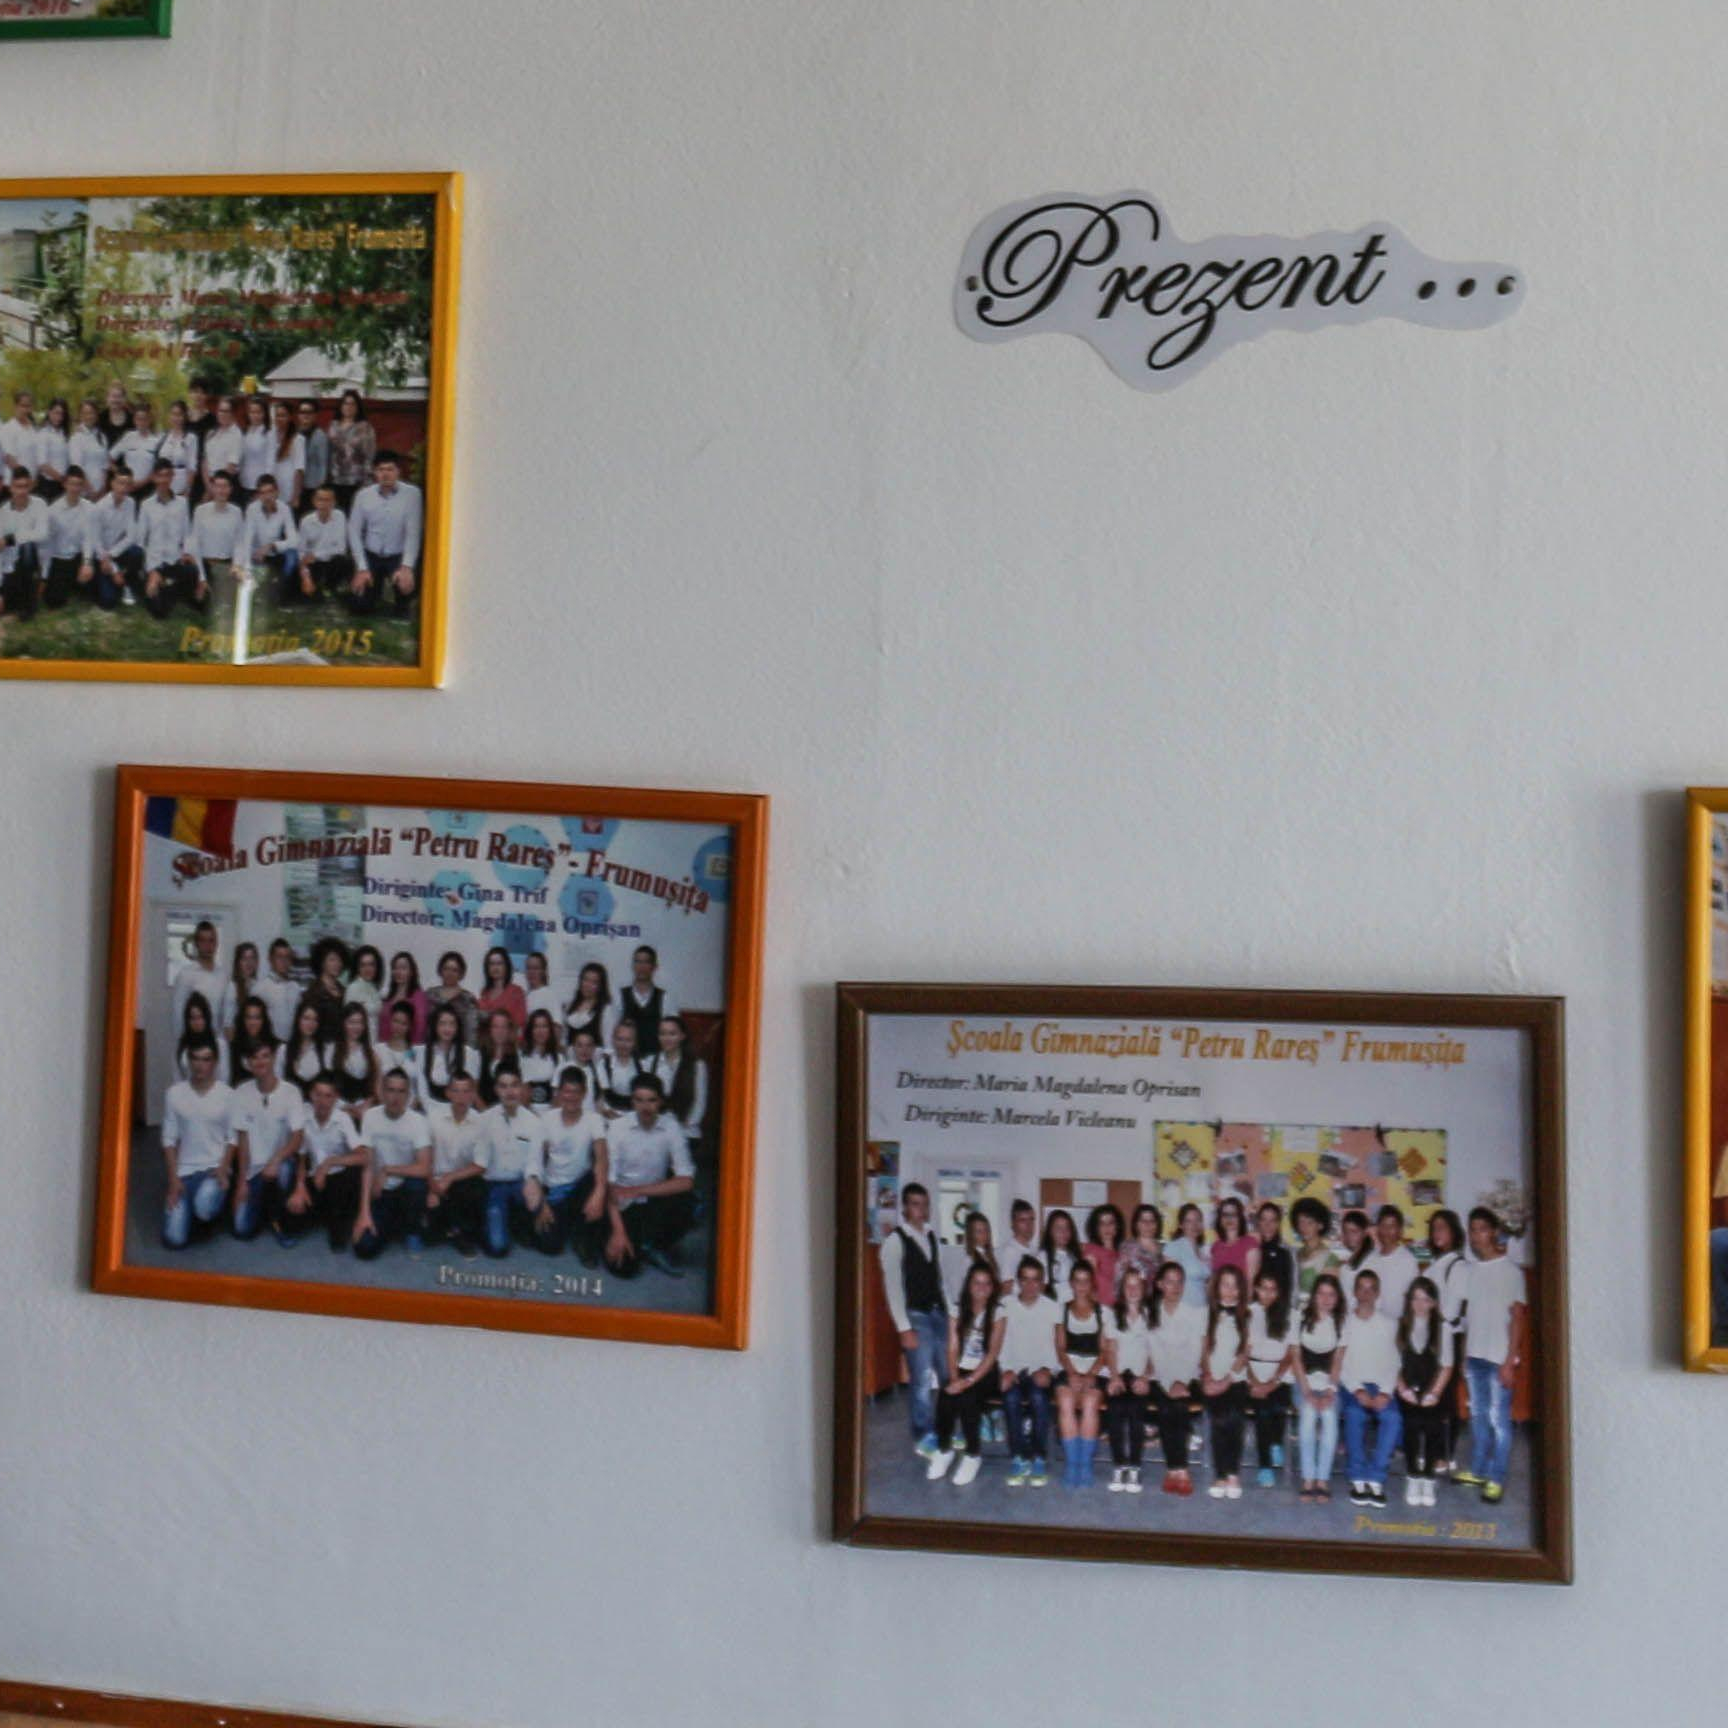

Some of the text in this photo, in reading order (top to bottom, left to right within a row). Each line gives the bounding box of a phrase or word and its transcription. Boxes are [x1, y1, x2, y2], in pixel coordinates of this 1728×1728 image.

[976, 199, 1387, 371] Prezent
[312, 629, 373, 657] 2015
[256, 827, 393, 867] Gimnazială
[400, 827, 479, 860] “Petru
[585, 848, 712, 915] Frumușița
[452, 910, 557, 933] Magdalena
[947, 1020, 1024, 1057] Școala
[1031, 1022, 1162, 1058] Gimnazială
[1170, 1027, 1246, 1059] “Petru
[974, 1074, 1028, 1092] Maria
[1032, 1076, 1127, 1100] Magdalena
[991, 1107, 1060, 1127] Marcela
[553, 1274, 603, 1297] 2014
